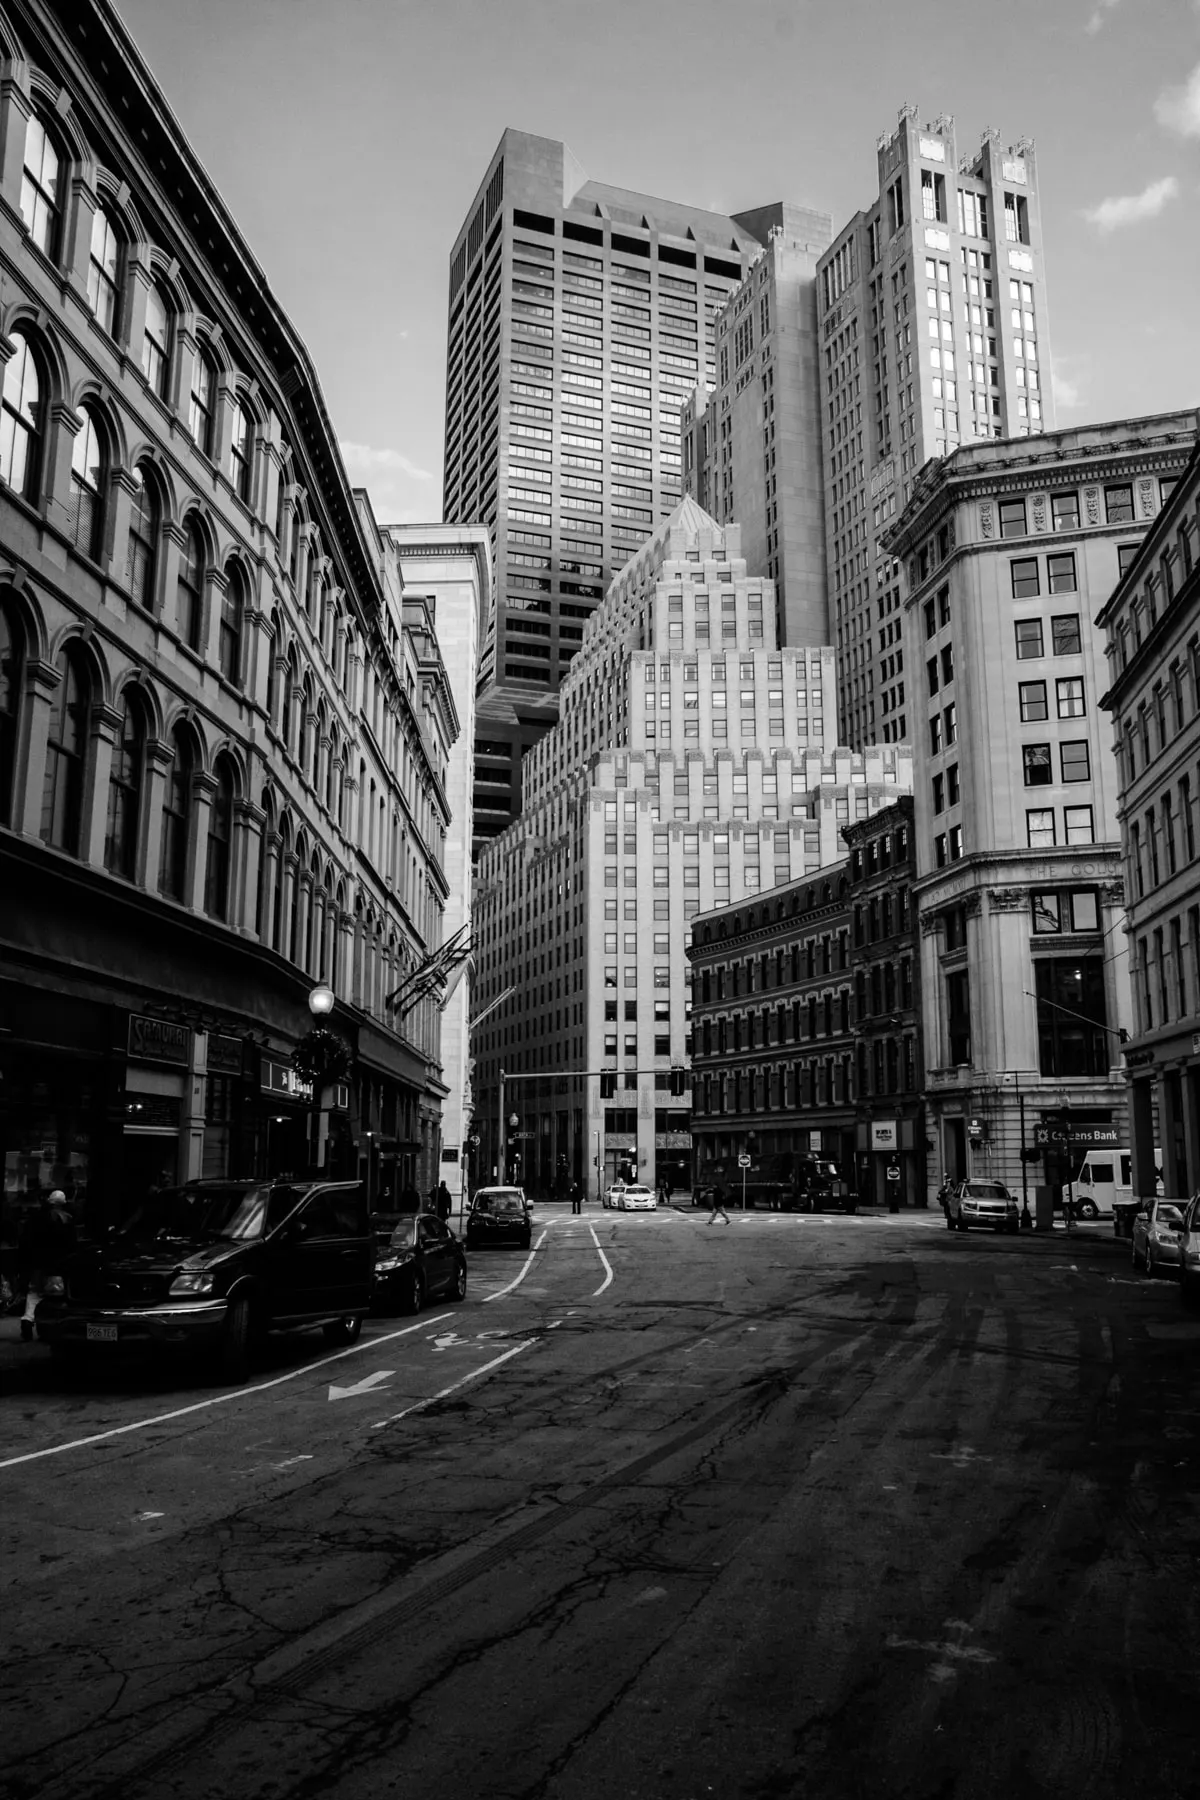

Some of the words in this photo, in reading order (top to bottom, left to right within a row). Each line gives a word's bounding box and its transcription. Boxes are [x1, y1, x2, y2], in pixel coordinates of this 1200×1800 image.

[1025, 866, 1057, 878] THE
[134, 1019, 187, 1052] SAMURAI
[1093, 1130, 1117, 1140] Bank
